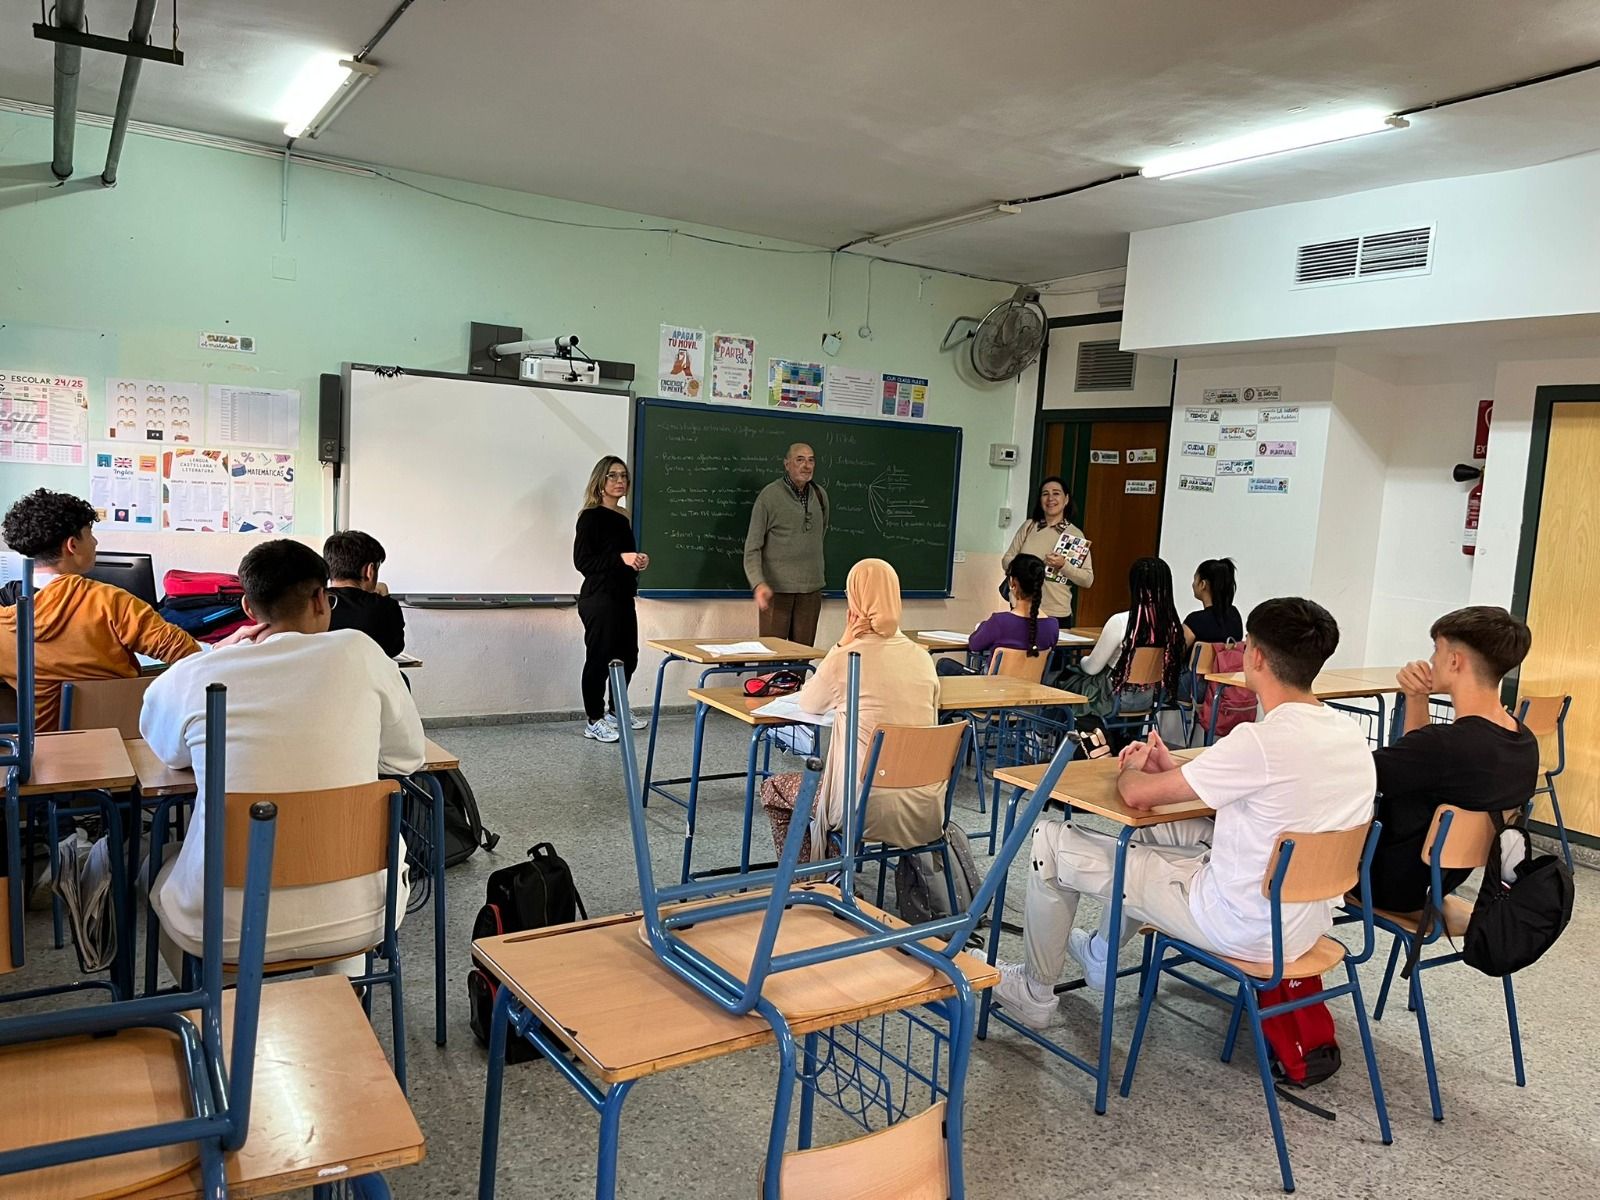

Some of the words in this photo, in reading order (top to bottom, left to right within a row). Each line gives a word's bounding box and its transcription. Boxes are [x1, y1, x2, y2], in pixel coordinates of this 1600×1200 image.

[672, 331, 694, 340] APAGA
[209, 342, 238, 350] material
[668, 338, 677, 347] TU
[12, 375, 51, 384] ESCOLAR
[54, 378, 83, 388] 24/25
